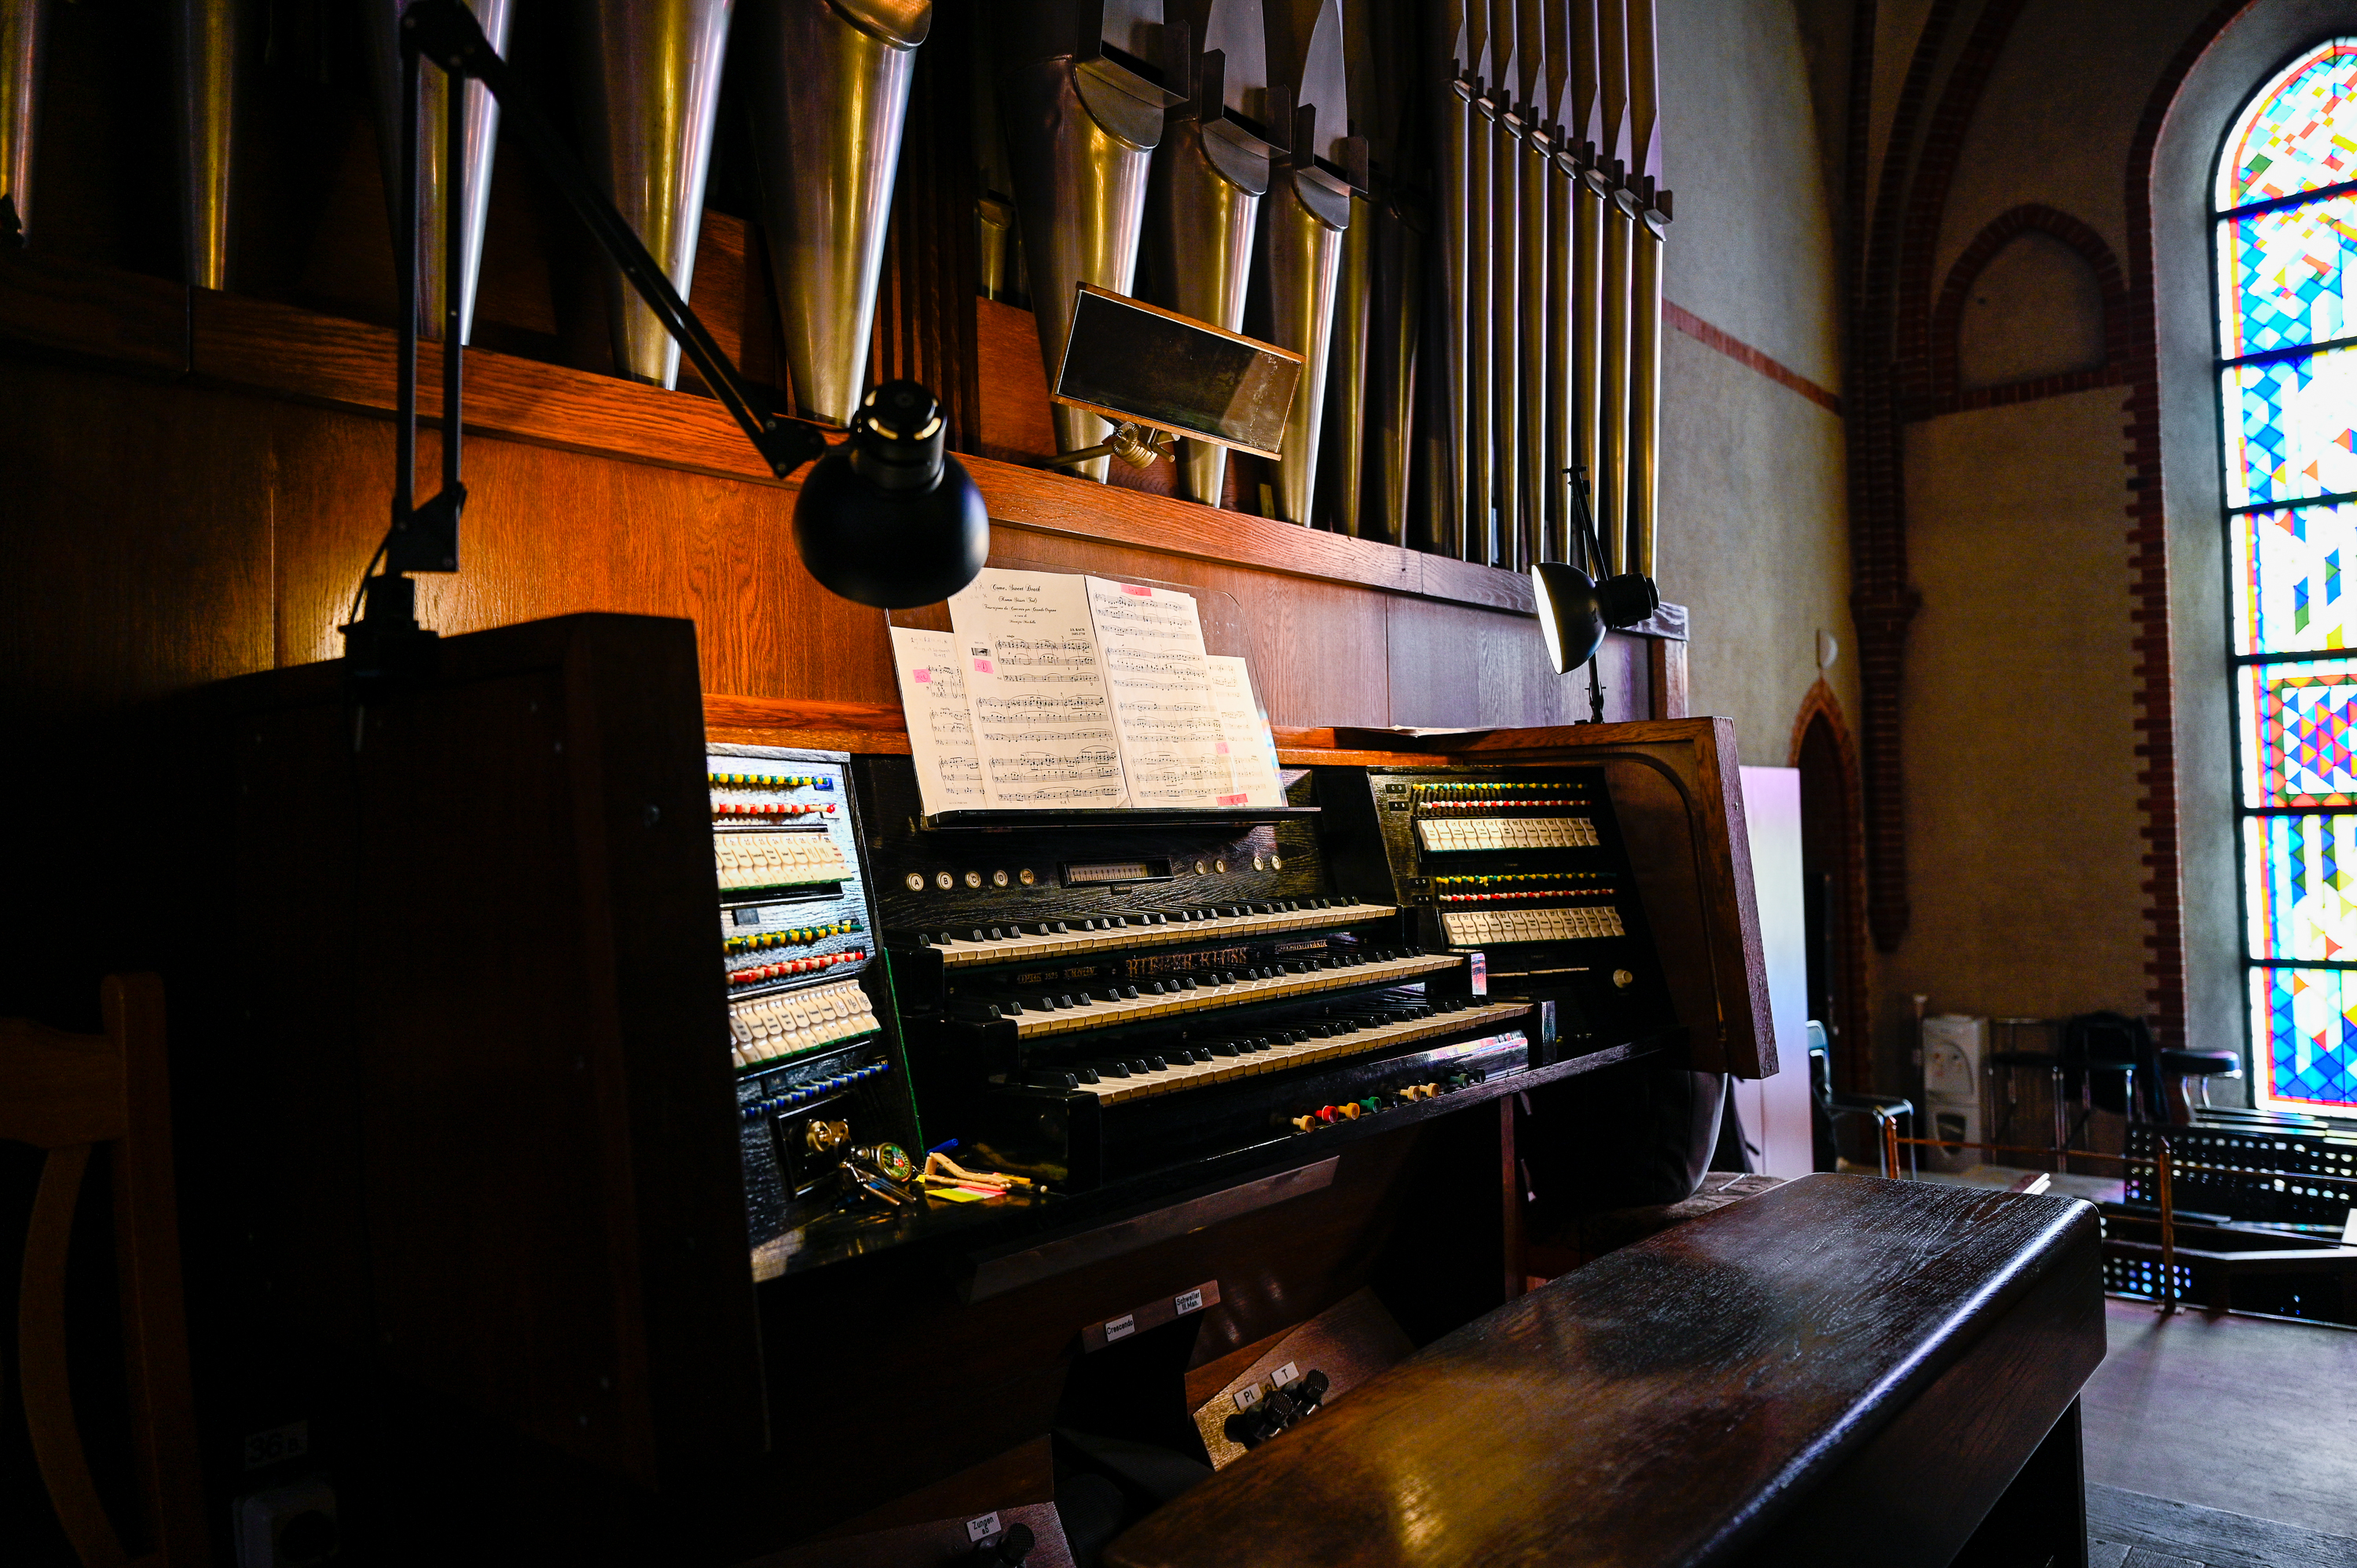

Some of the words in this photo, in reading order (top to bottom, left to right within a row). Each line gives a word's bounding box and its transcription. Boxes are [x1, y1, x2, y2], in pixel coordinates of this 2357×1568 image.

[913, 877, 920, 887] A
[943, 877, 948, 885] B
[972, 875, 977, 884] C
[1176, 1292, 1200, 1306] Schweller
[1106, 1319, 1134, 1335] Crescendo
[1281, 1368, 1288, 1379] T
[249, 1432, 283, 1464] 36
[972, 1516, 995, 1530] Zungen
[981, 1525, 990, 1535] ab
